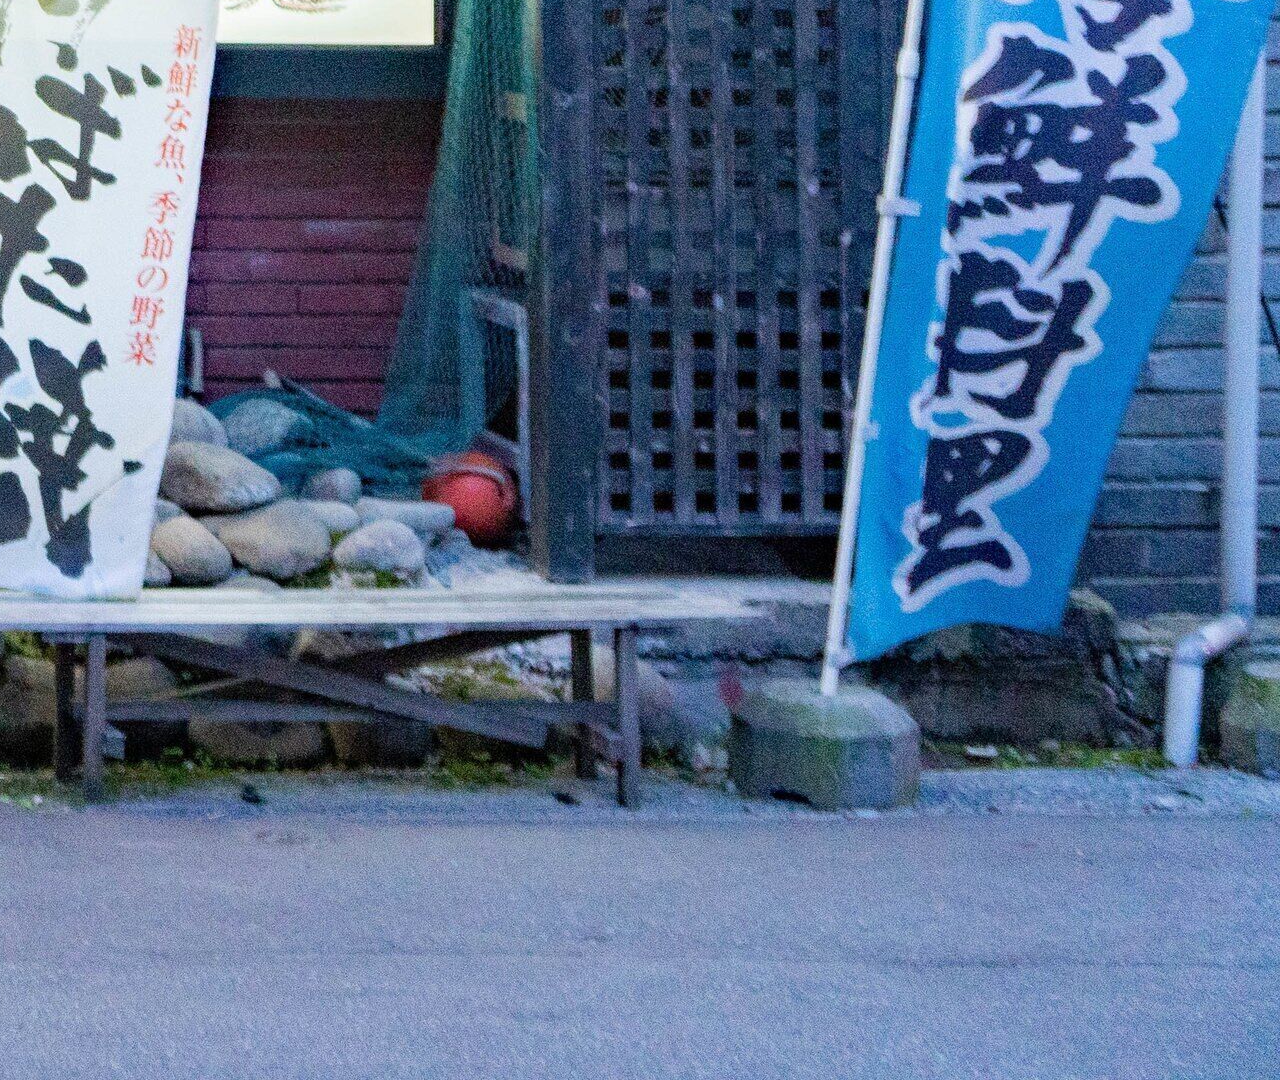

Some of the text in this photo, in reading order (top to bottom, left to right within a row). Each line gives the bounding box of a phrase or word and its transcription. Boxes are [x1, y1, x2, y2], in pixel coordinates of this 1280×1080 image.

[126, 22, 204, 367] 新鮮な魚、季節の野菜
